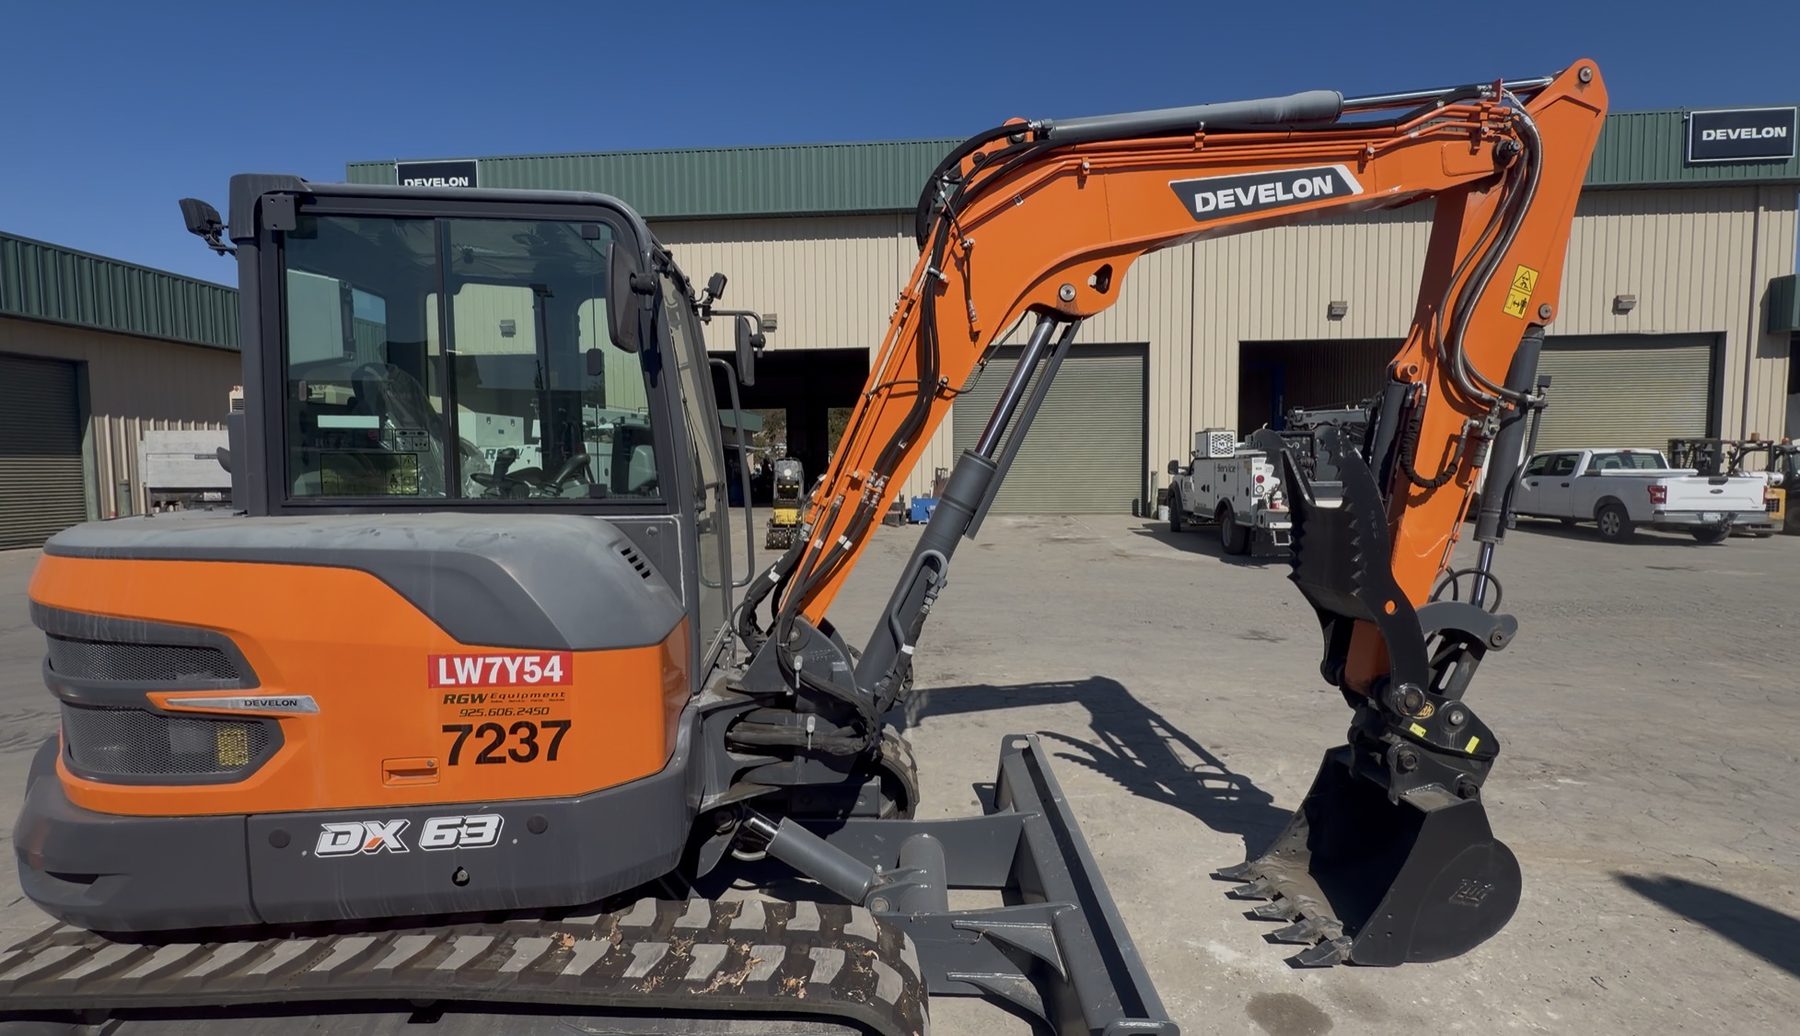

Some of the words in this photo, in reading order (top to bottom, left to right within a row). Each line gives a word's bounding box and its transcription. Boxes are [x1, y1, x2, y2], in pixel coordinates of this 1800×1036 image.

[1702, 126, 1787, 141] DEVELON
[404, 177, 469, 187] DEVELON
[1194, 174, 1334, 214] DEVELON
[438, 655, 563, 685] LW7Y54
[244, 699, 298, 707] DEVELON
[443, 693, 488, 705] RGW
[490, 691, 567, 700] Equipment
[459, 706, 550, 718] 925.606.2450
[442, 719, 572, 767] 7237
[314, 818, 411, 858] DX
[419, 813, 505, 851] 63
